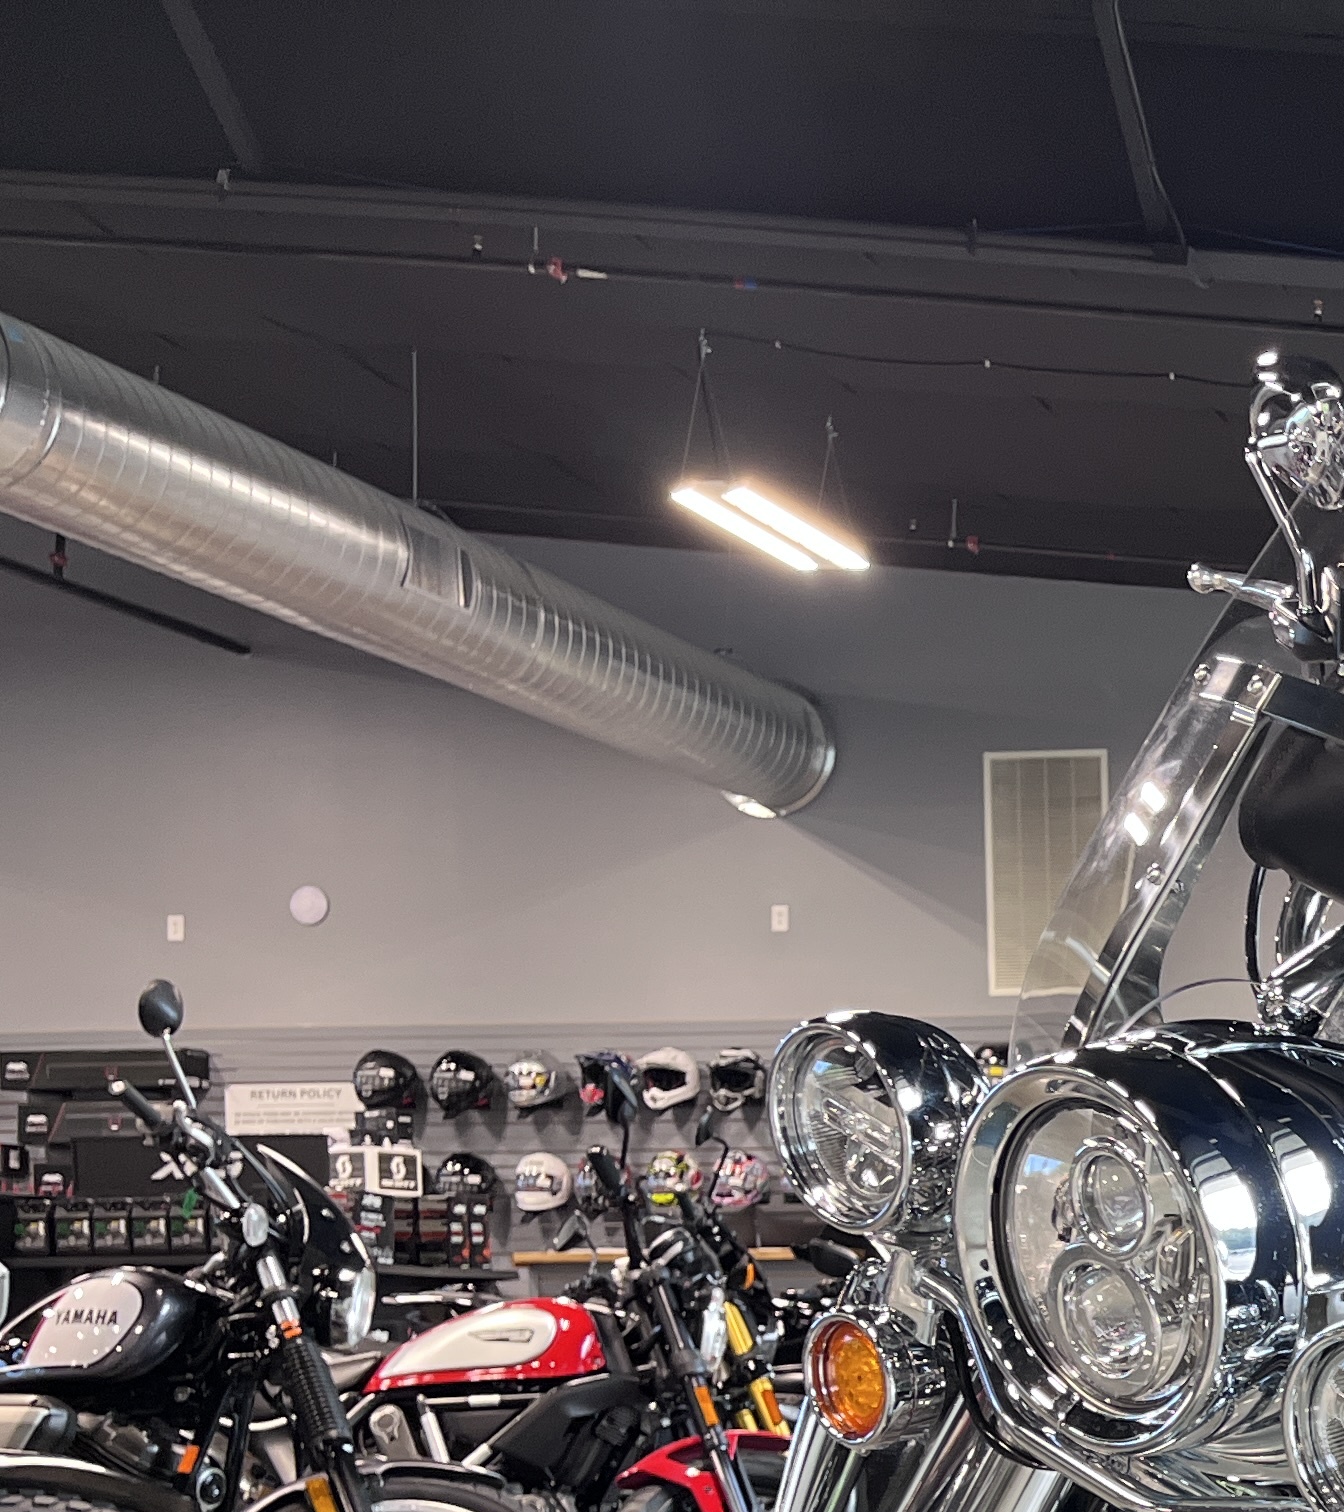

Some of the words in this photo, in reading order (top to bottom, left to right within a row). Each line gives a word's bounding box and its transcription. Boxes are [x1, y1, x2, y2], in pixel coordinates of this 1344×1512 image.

[250, 1089, 297, 1101] RETURN
[300, 1087, 342, 1099] POLICY
[55, 1309, 119, 1326] YAMAHA
